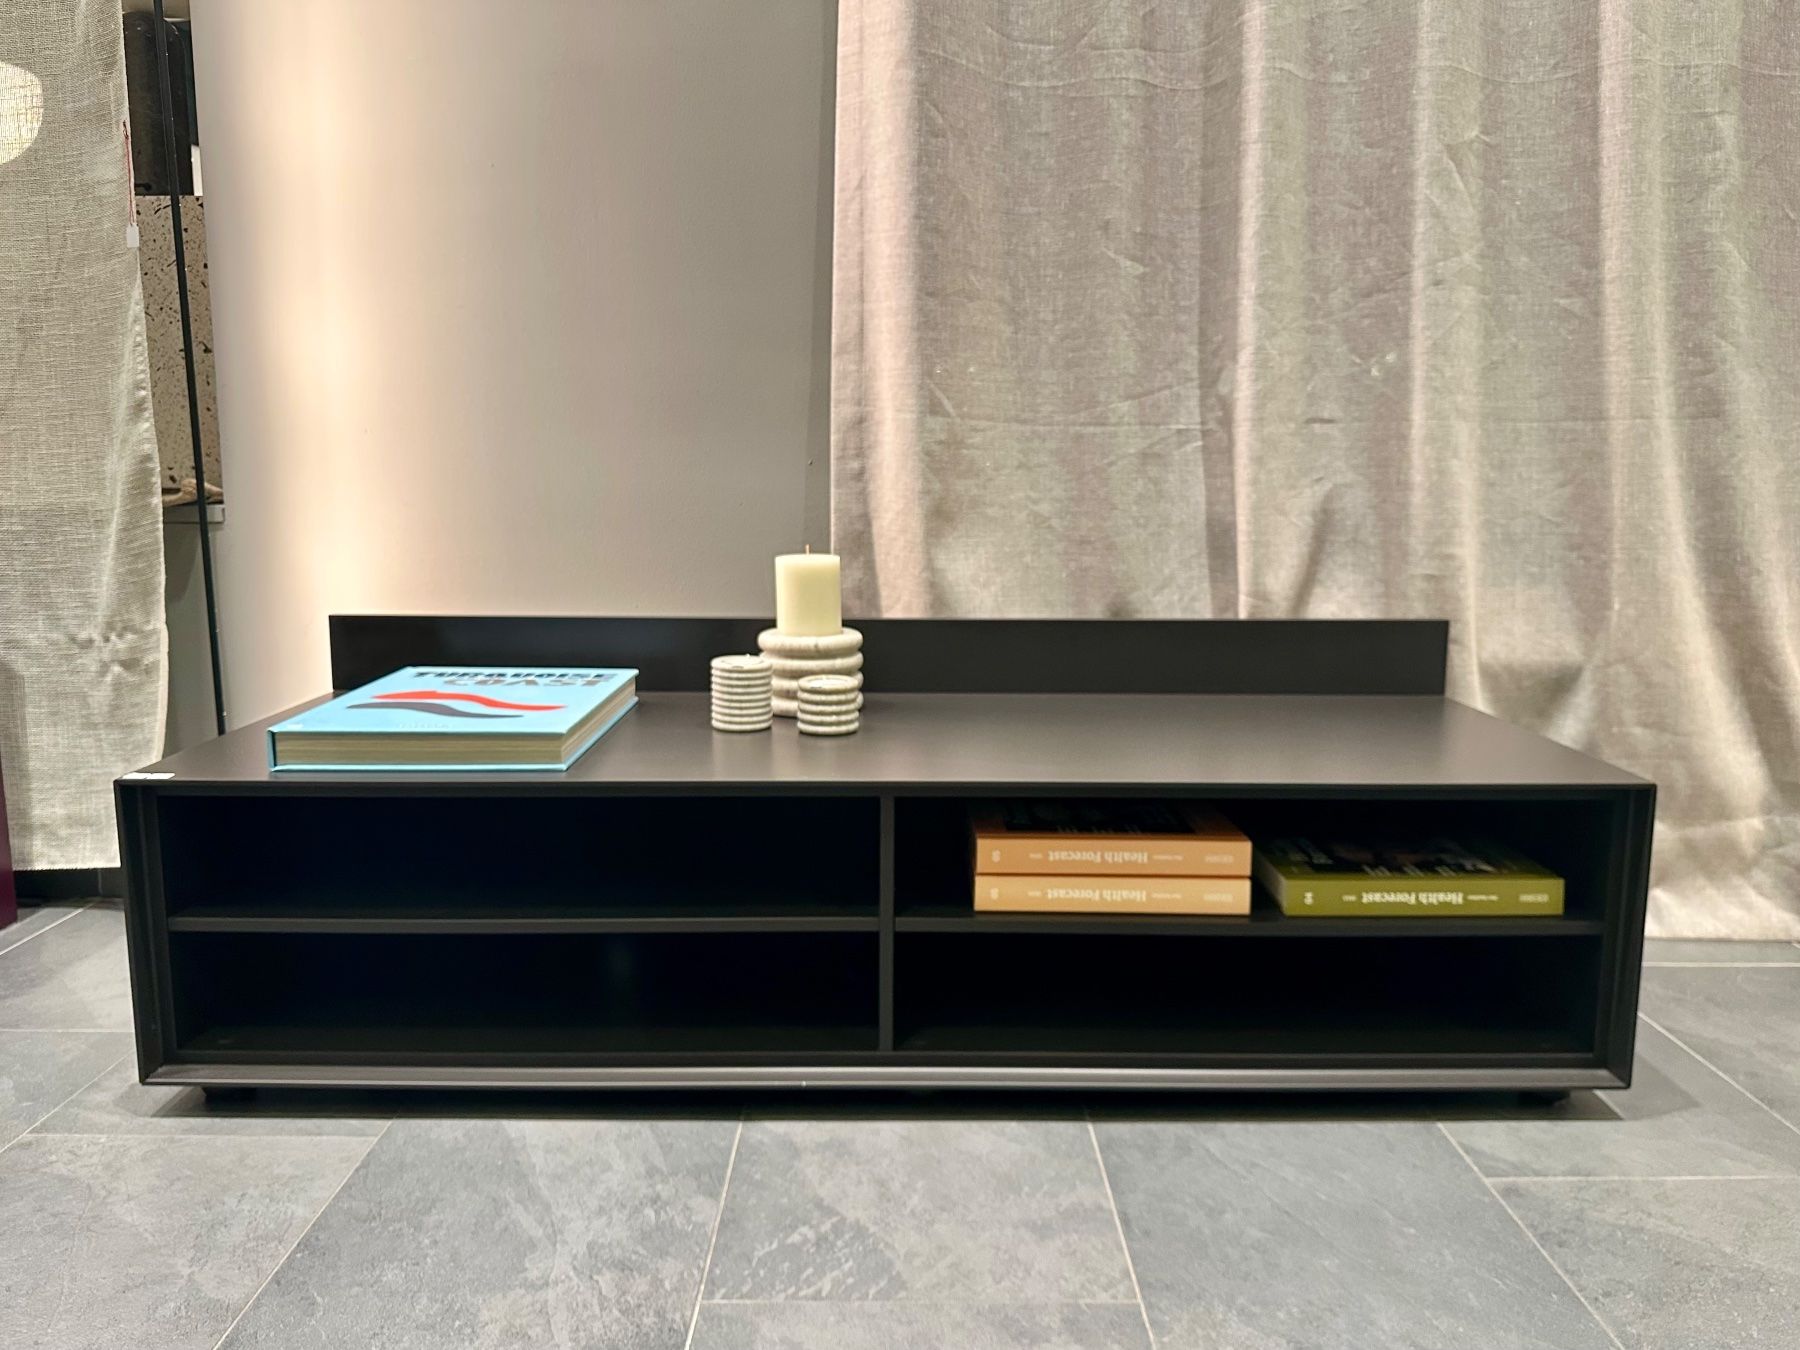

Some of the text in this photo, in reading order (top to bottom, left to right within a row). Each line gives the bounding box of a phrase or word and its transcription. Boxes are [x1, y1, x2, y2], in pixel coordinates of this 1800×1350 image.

[445, 678, 605, 687] COAST
[1048, 850, 1102, 862] Forecast
[1104, 851, 1148, 863] Health
[1046, 888, 1100, 901] Forecast
[1103, 889, 1147, 902] Health
[1361, 891, 1416, 904] Forecast
[1418, 892, 1463, 905] Health
